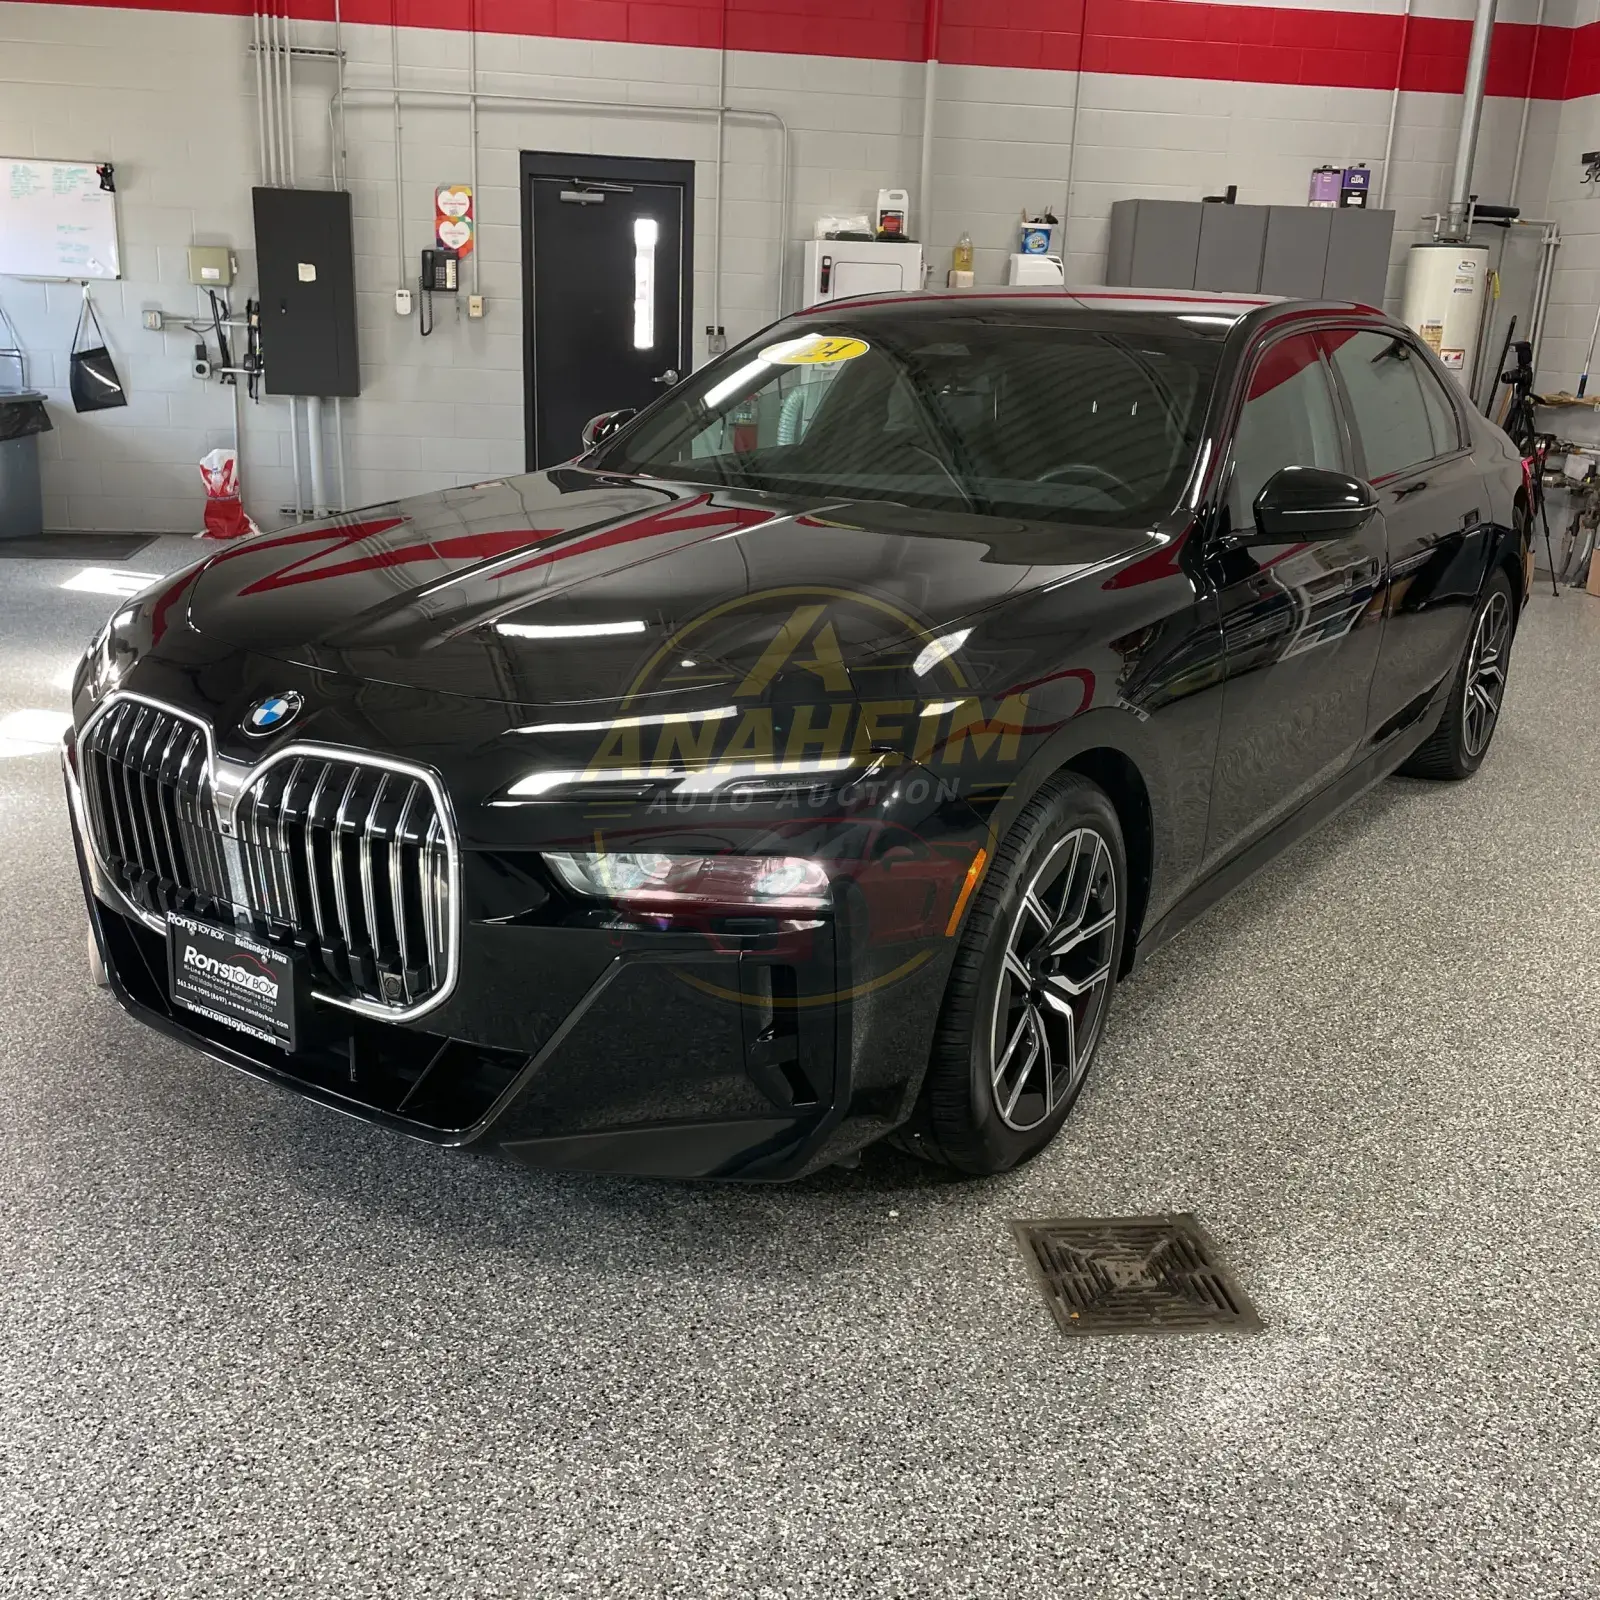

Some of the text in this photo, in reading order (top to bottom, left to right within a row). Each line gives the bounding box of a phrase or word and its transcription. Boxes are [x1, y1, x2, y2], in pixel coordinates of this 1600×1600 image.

[198, 924, 211, 935] TOY
[210, 929, 225, 942] BOX
[270, 949, 288, 965] Iowa
[231, 969, 252, 986] TOY
[252, 977, 276, 997] BOX
[187, 1002, 277, 1045] www.ronstoybox.com
